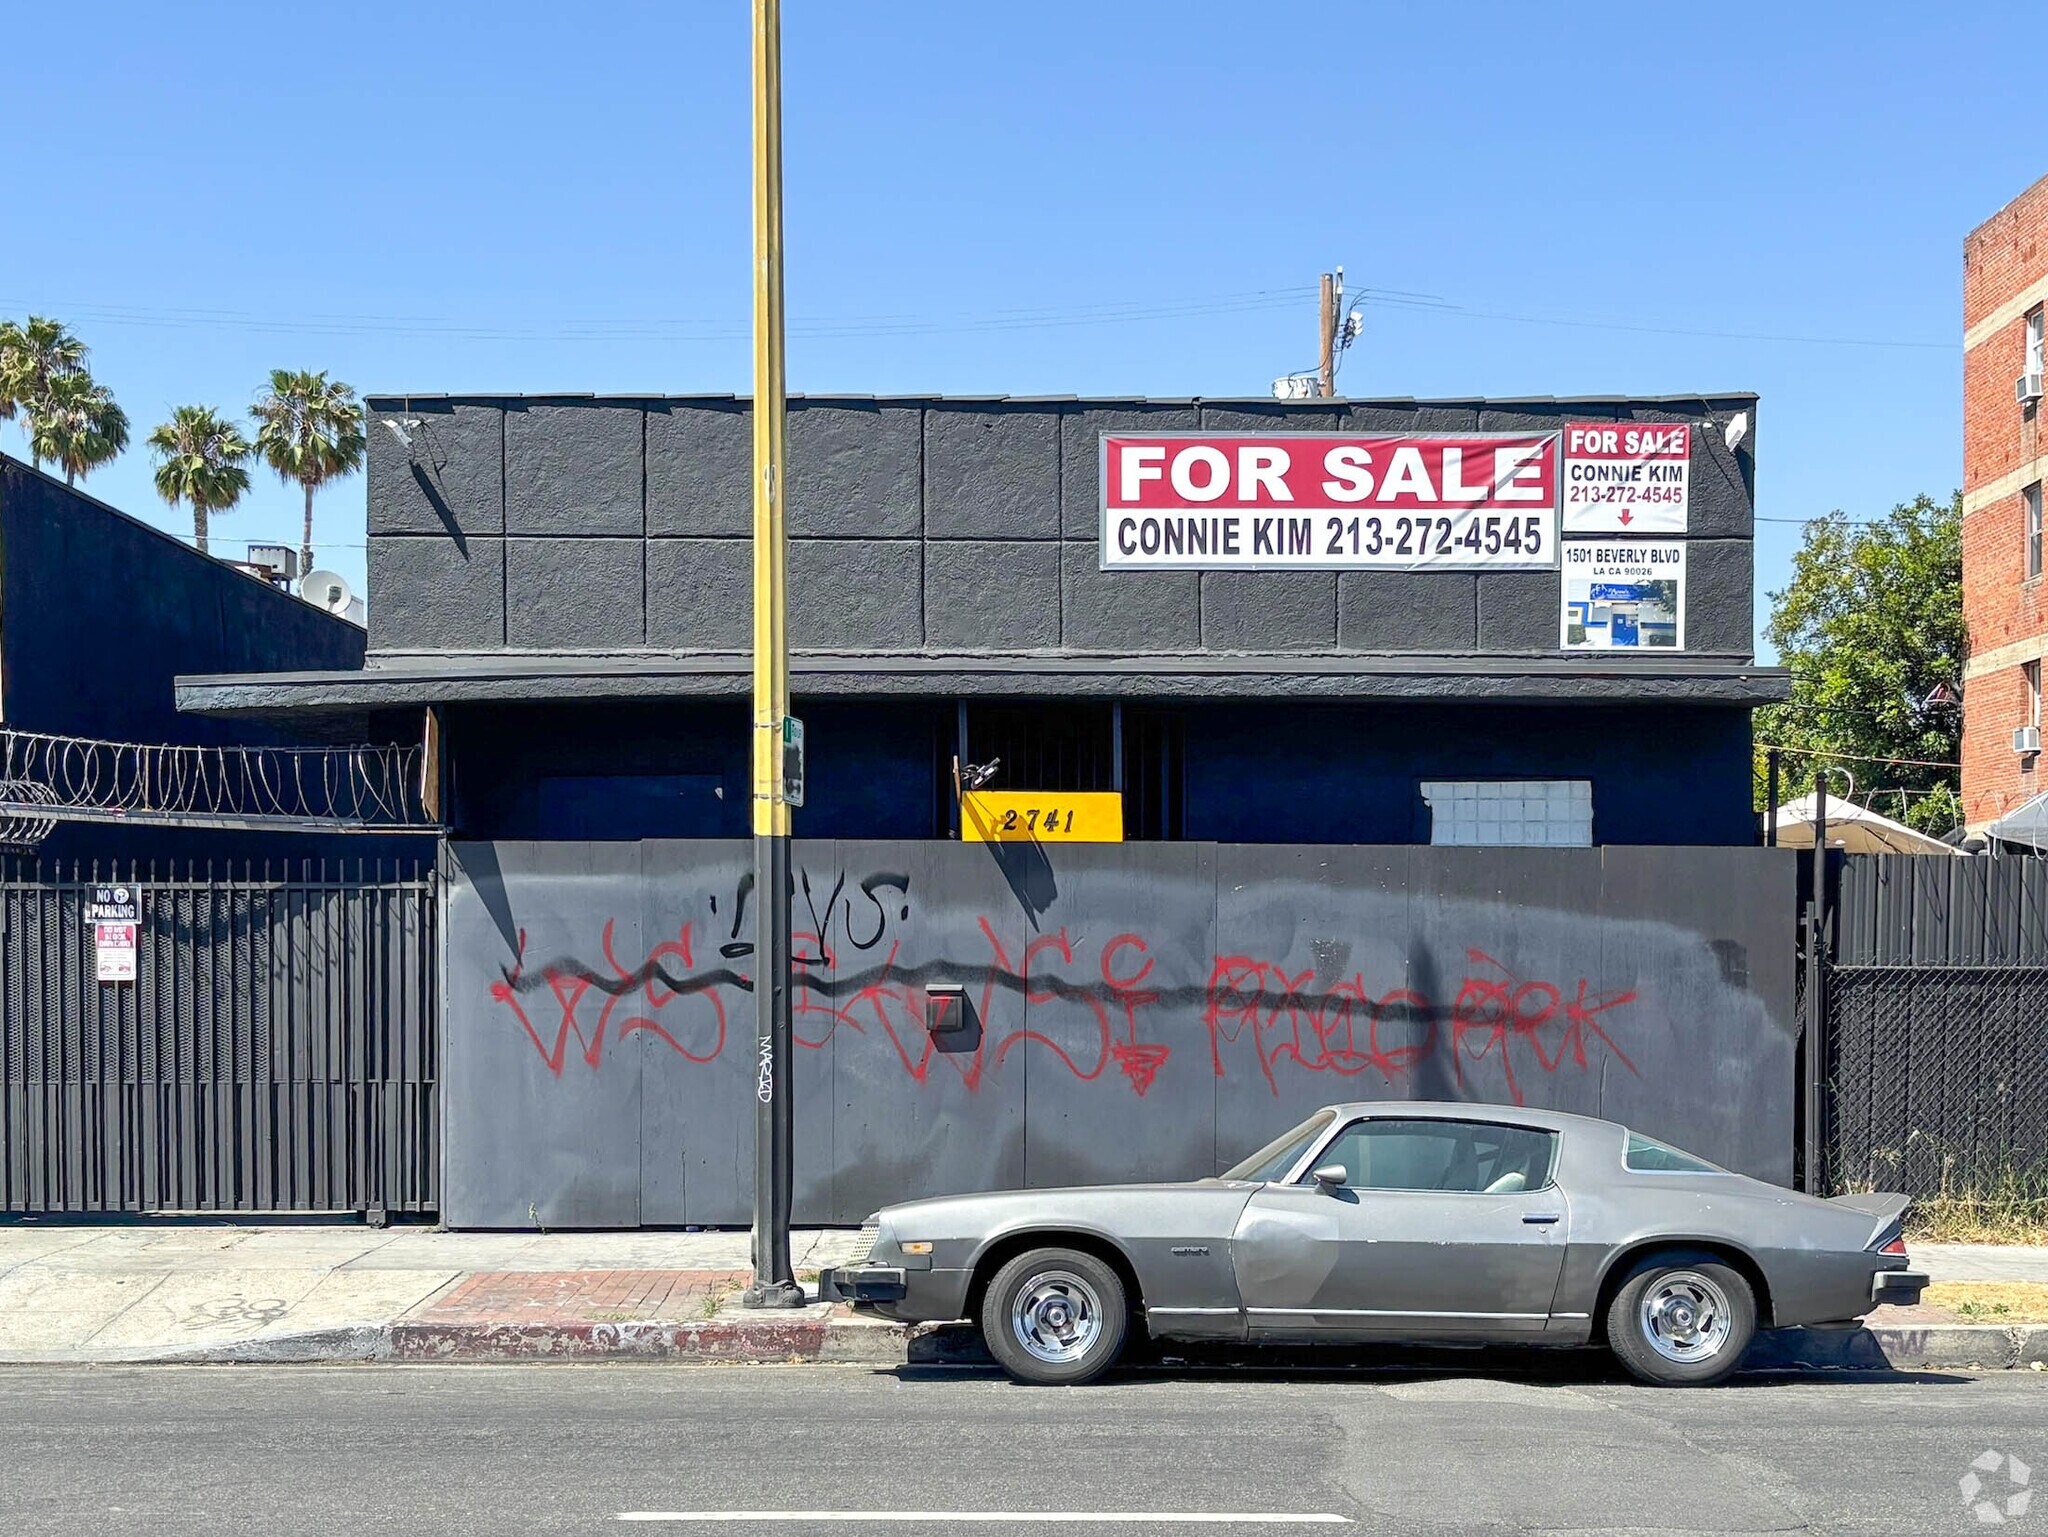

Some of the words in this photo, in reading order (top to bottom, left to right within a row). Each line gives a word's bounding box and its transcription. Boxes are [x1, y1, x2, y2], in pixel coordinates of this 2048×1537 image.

[1570, 430, 1618, 454] FOR
[1624, 430, 1684, 454] SALE
[1121, 445, 1294, 503] FOR
[1321, 445, 1544, 503] SALE
[1571, 464, 1642, 482] CONNIE
[1649, 465, 1683, 482] KIM
[1570, 485, 1683, 504] 213-272-4545
[1118, 517, 1240, 556] CONNIE
[1253, 517, 1312, 556] KIM
[1326, 516, 1541, 556] 213-272-4545
[1566, 548, 1592, 563] 1501
[1596, 549, 1647, 563] BEVERLY
[1651, 549, 1680, 564] BLVD
[1593, 567, 1605, 576] LA
[1608, 567, 1621, 576] CA
[1624, 567, 1653, 576] 90026
[1003, 808, 1074, 833] 2741
[96, 889, 111, 903] NO
[91, 904, 135, 918] PARKING
